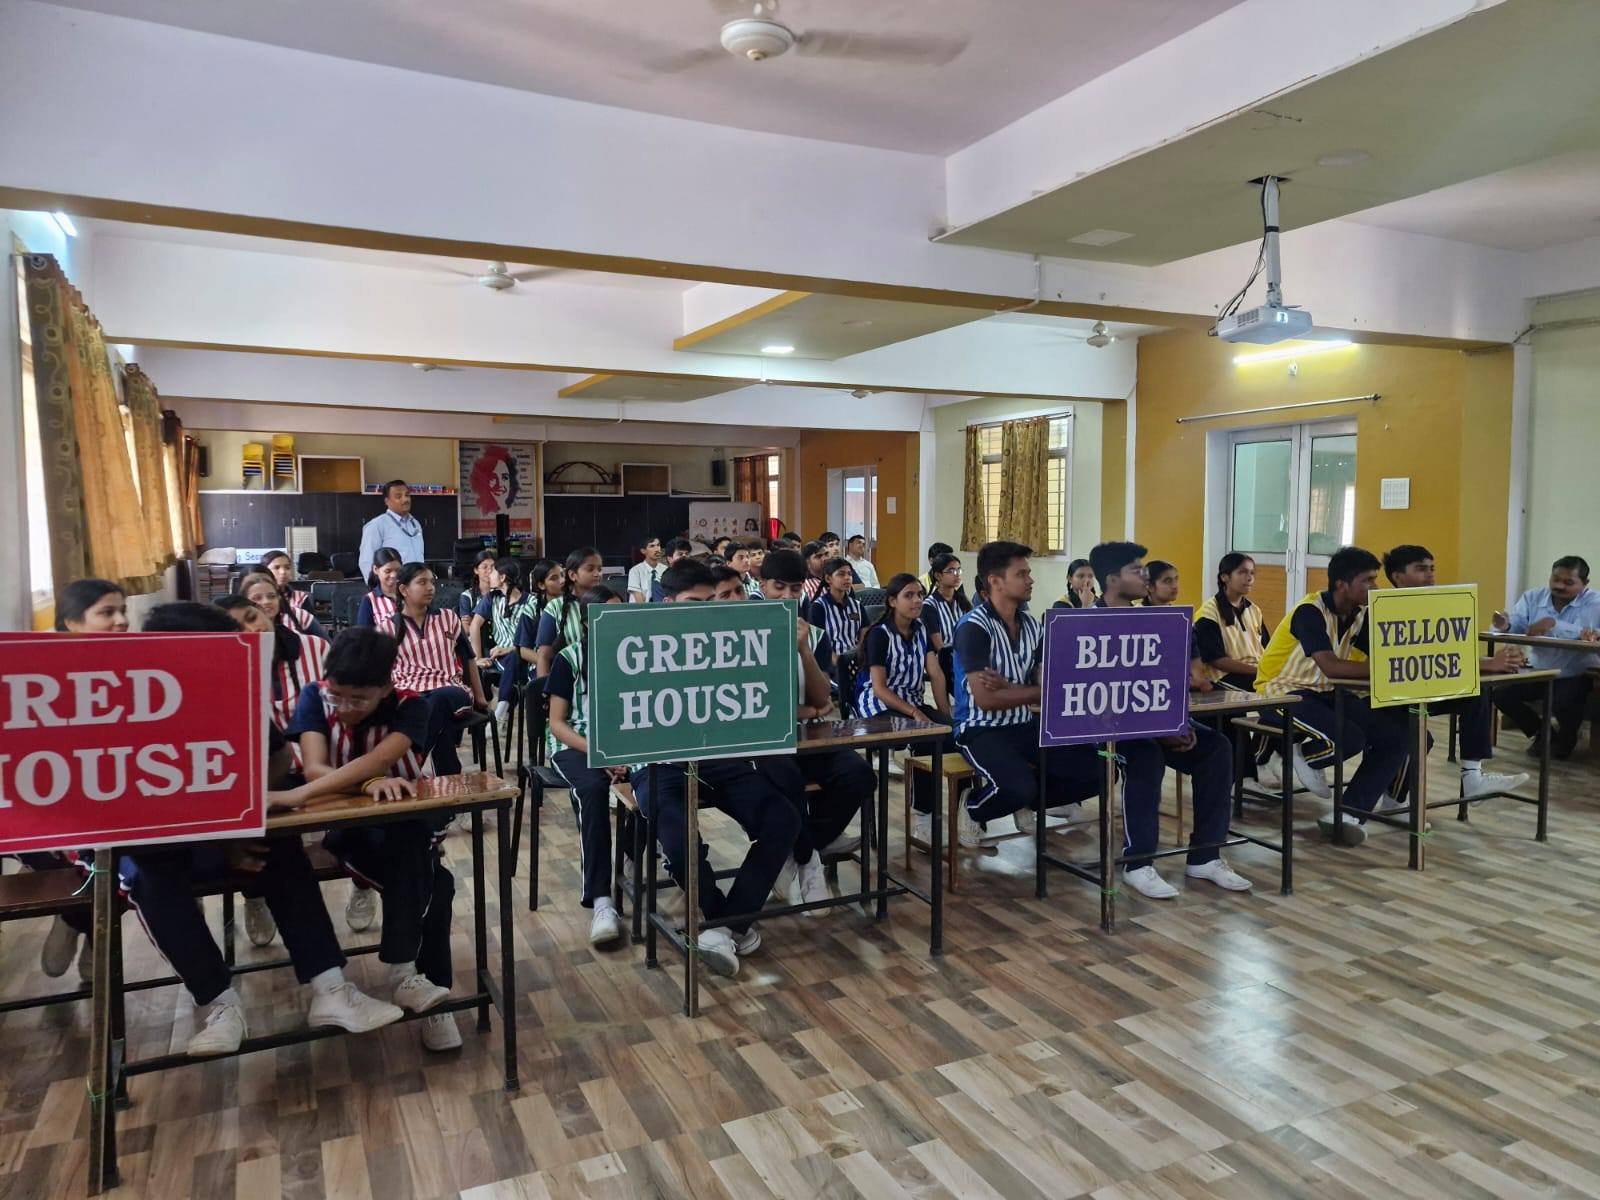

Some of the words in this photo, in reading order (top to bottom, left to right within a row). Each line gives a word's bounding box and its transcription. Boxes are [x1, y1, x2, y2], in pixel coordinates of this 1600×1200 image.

[616, 628, 772, 675] GREEN
[1075, 633, 1162, 669] BLUE
[1377, 616, 1472, 647] YELLOW
[1388, 653, 1462, 683] HOUSE
[1, 669, 183, 729] RED
[618, 681, 771, 731] HOUSE
[1061, 678, 1171, 717] HOUSE
[0, 740, 238, 808] OUSE
